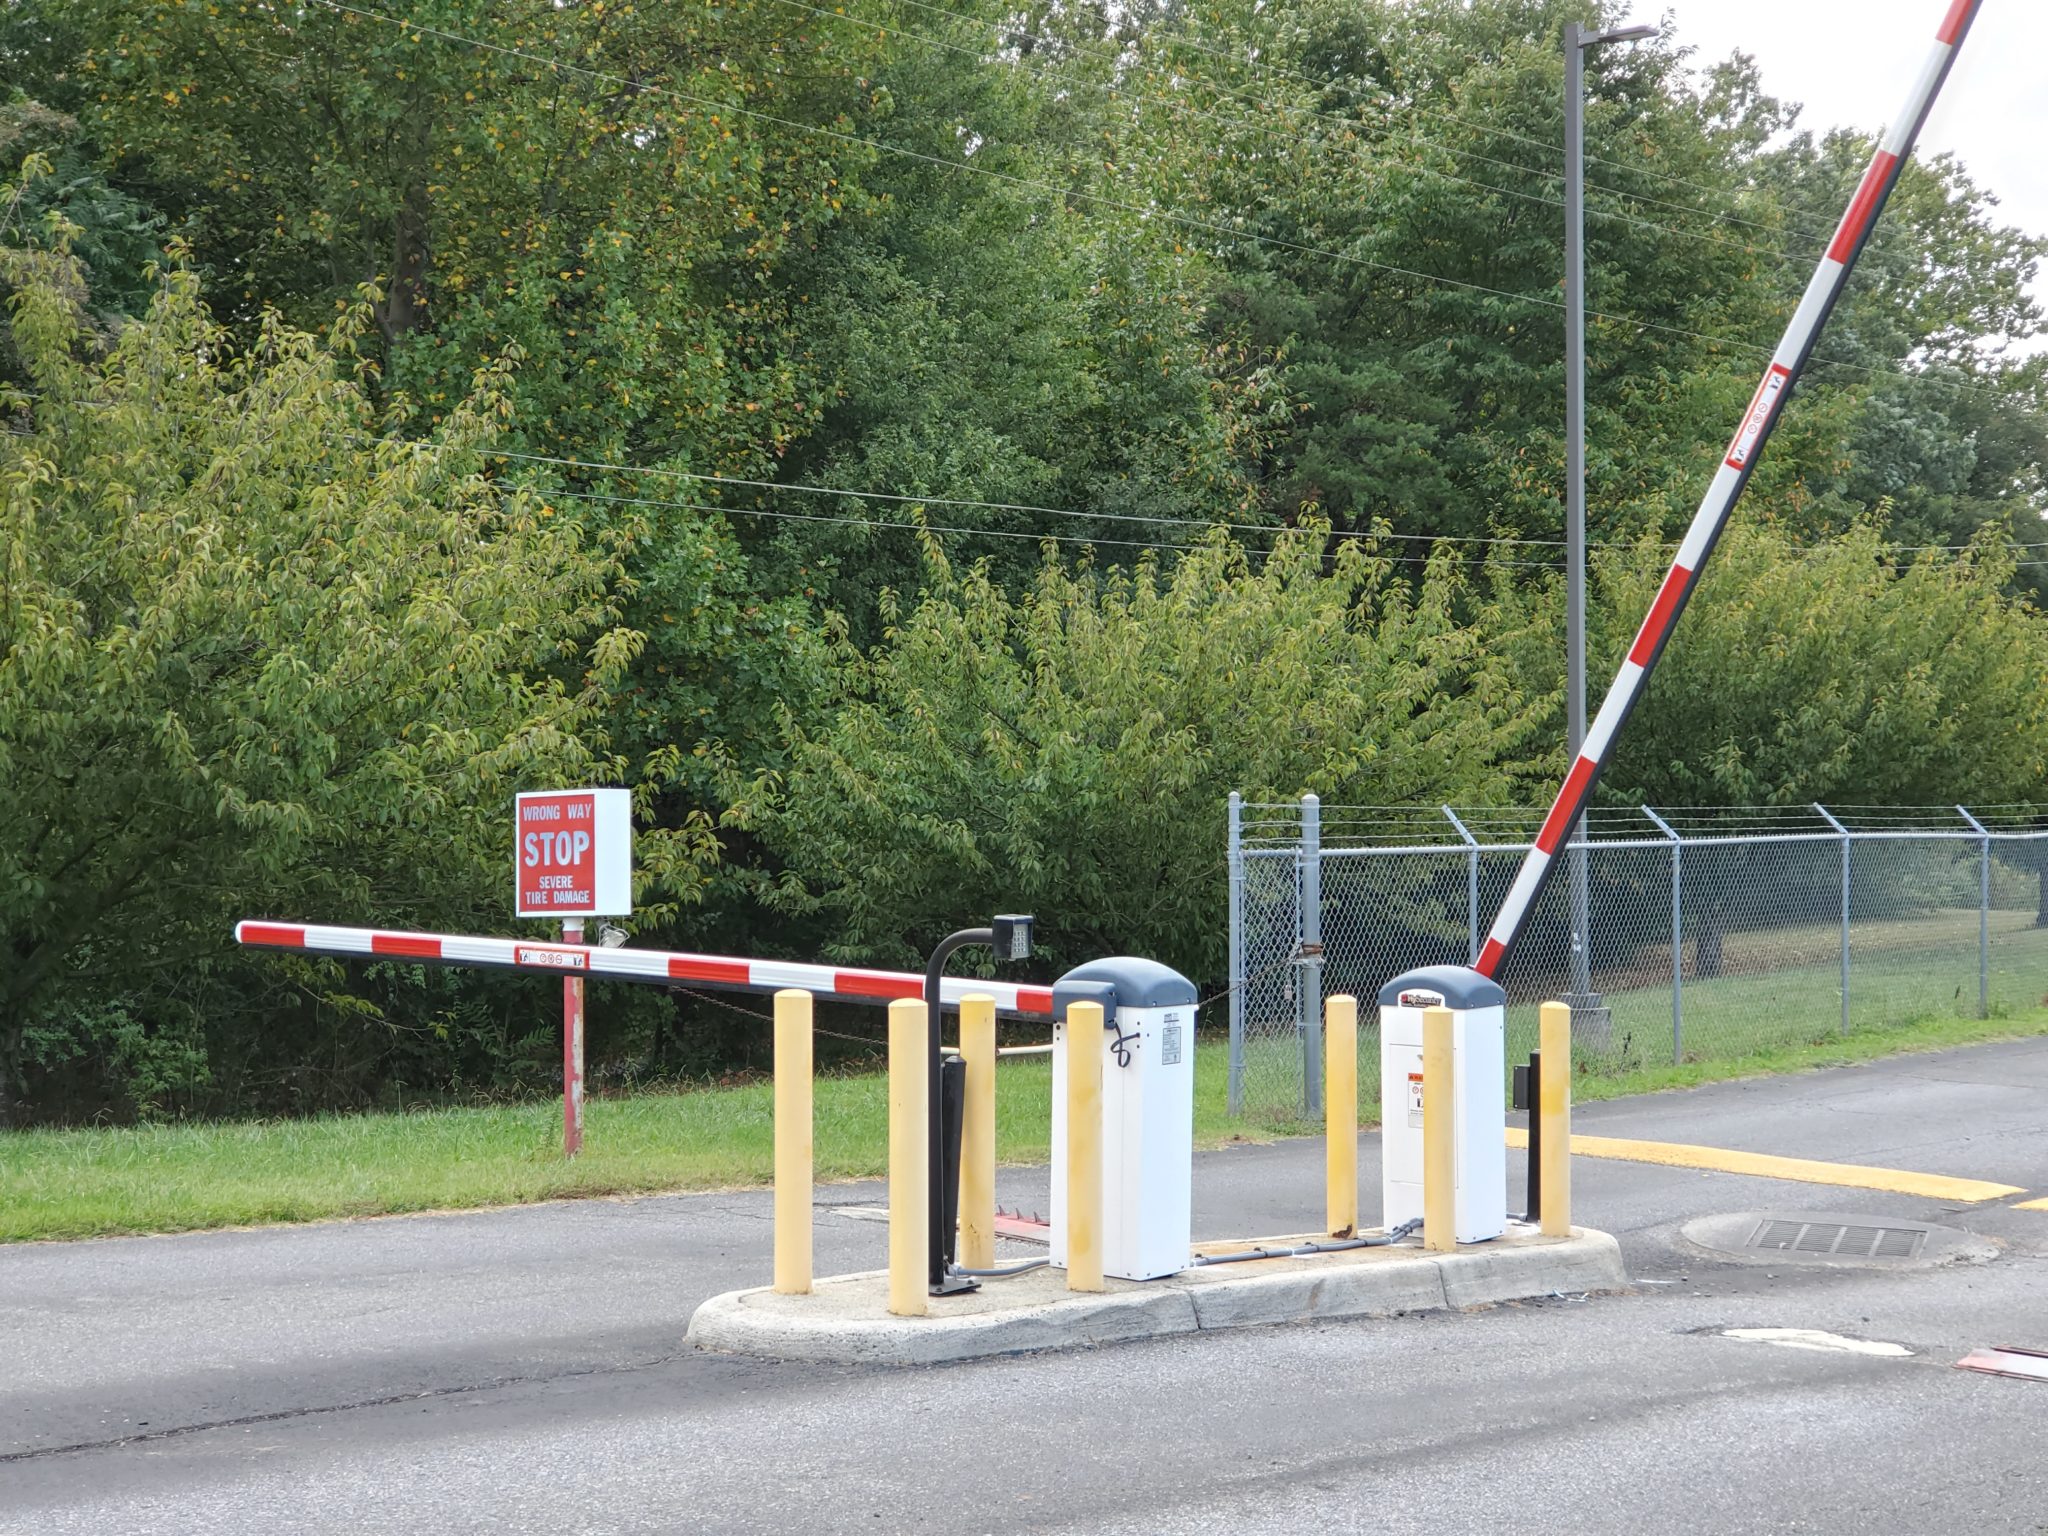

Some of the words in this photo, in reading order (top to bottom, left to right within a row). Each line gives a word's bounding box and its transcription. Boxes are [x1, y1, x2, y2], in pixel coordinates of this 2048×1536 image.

[523, 805, 560, 821] WRONG
[568, 804, 592, 819] WAY
[524, 831, 590, 867] STOP
[539, 875, 573, 889] SEVERE
[525, 891, 548, 904] TIRE
[553, 890, 590, 904] DAMAGE
